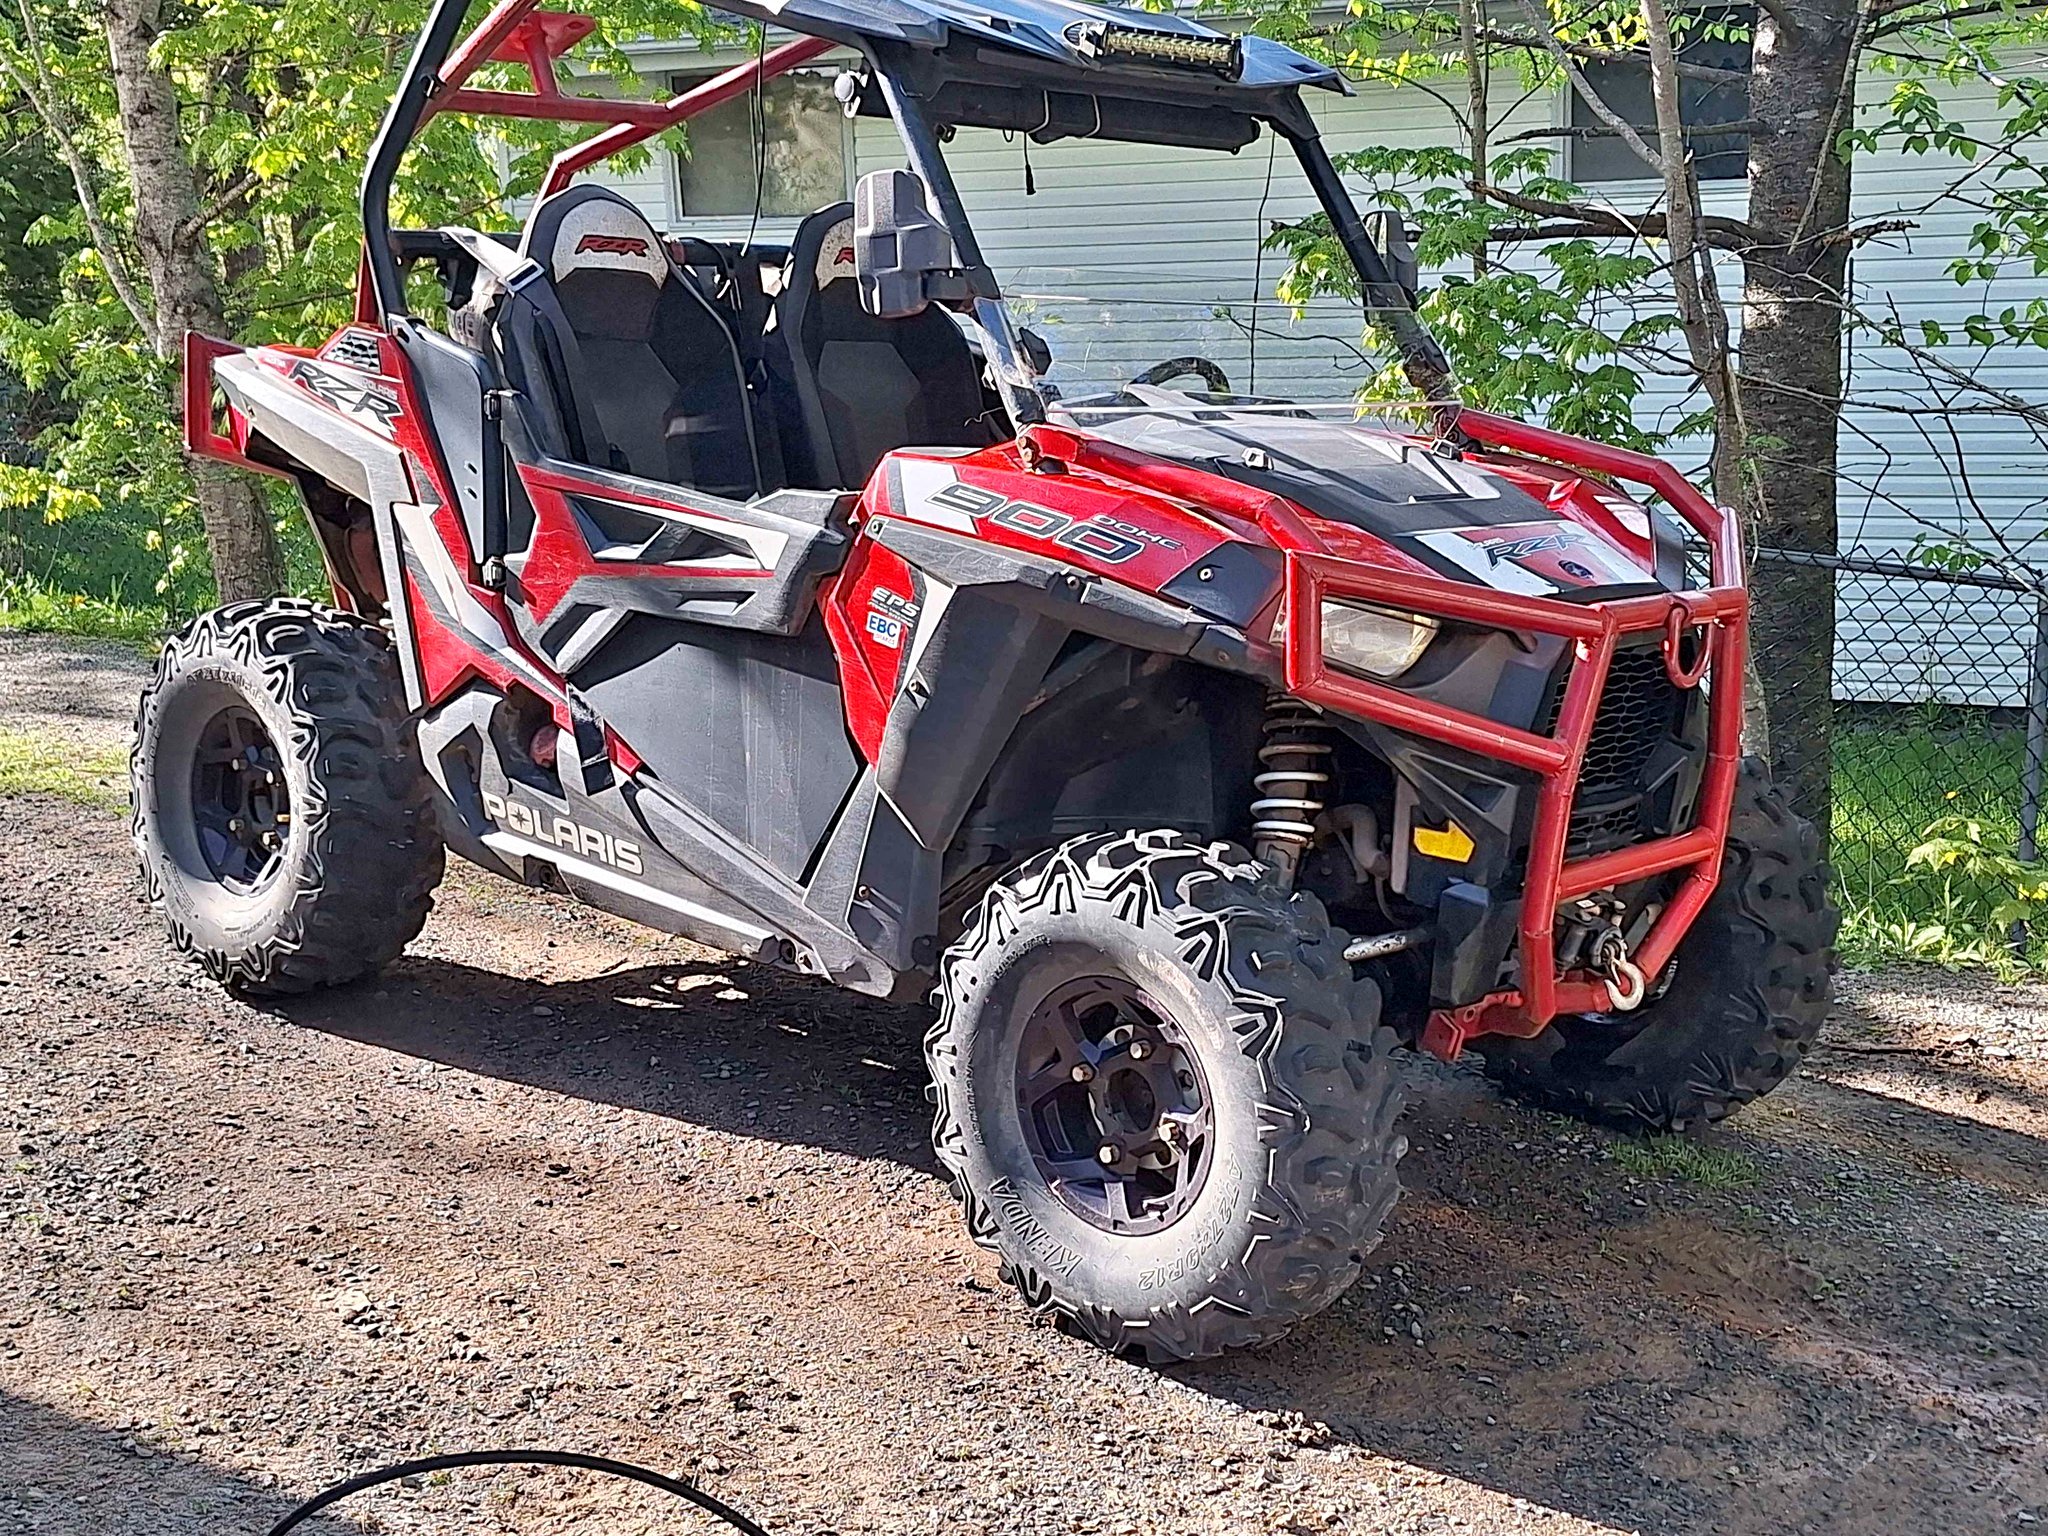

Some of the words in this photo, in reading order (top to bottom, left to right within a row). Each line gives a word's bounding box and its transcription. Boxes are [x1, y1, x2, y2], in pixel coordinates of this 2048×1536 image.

[574, 234, 650, 257] RZR
[289, 359, 403, 430] RZR
[361, 378, 398, 398] POLARIS
[925, 481, 1147, 564] 900
[1092, 514, 1184, 550] DOHC
[872, 587, 921, 617] EPS
[869, 615, 898, 638] EBC
[481, 790, 644, 875] POLARIS
[989, 1175, 1084, 1278] KENDA
